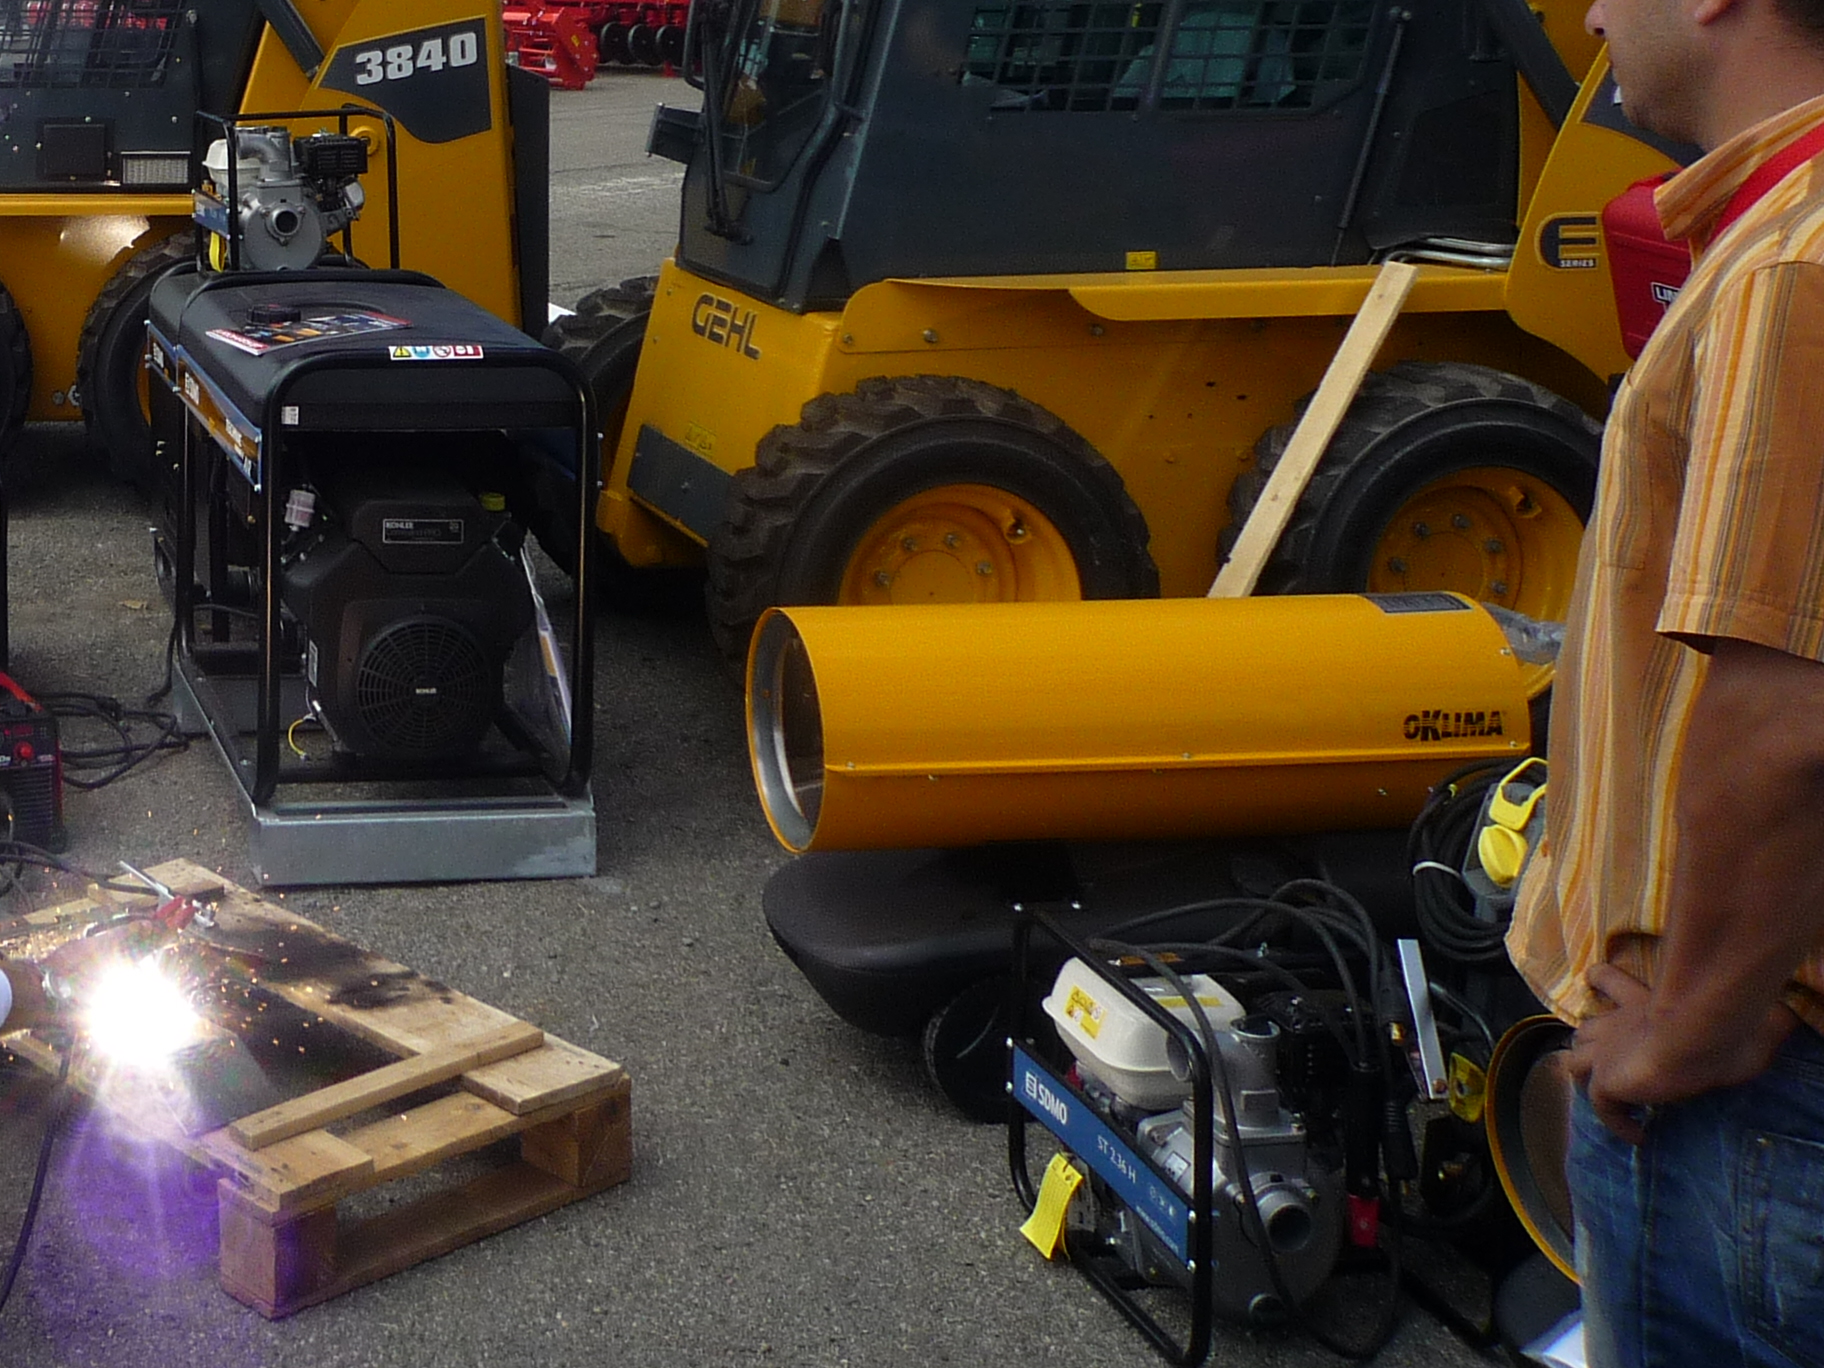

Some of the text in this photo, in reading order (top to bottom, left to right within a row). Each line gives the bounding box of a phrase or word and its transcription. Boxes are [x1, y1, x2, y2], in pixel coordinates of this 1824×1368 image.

[354, 32, 478, 85] 3840
[1560, 258, 1595, 268] SERIES
[691, 292, 762, 360] GEHL
[1402, 709, 1504, 742] OKLIMA
[1037, 1081, 1069, 1126] SDMO
[1097, 1134, 1108, 1155] ST
[1128, 1165, 1136, 1184] H
